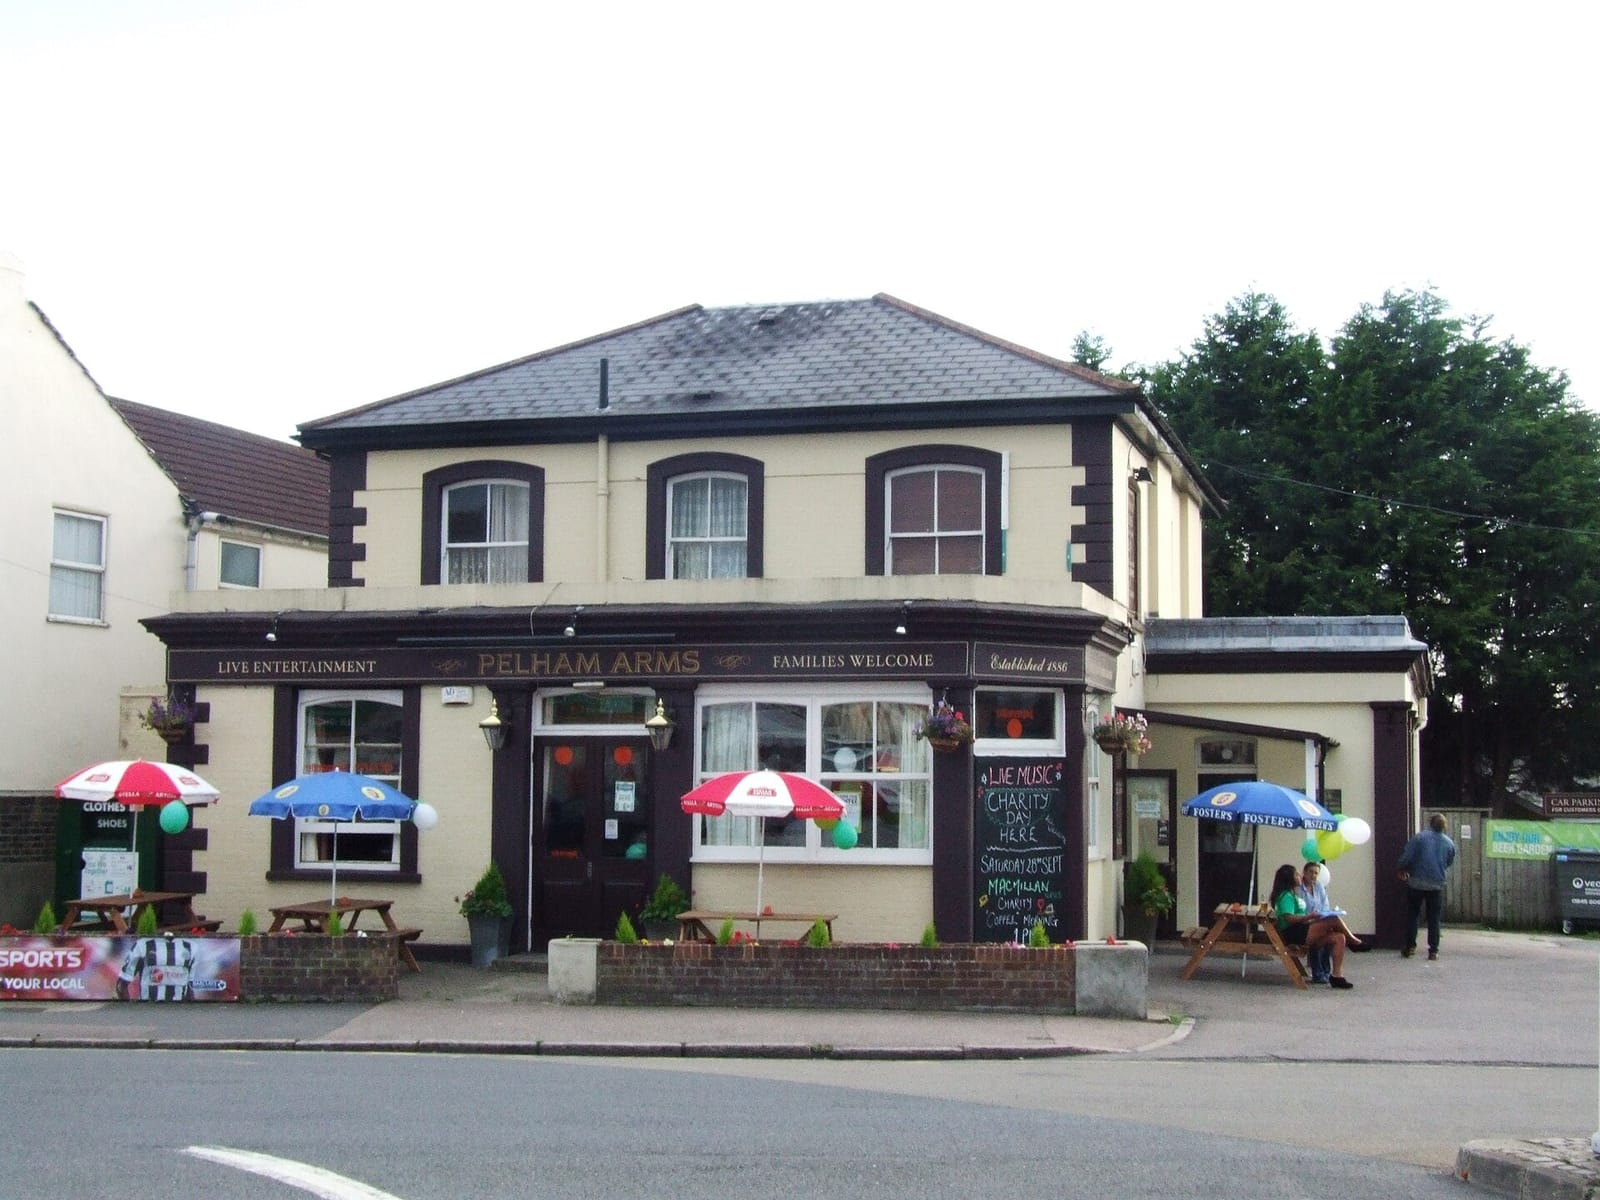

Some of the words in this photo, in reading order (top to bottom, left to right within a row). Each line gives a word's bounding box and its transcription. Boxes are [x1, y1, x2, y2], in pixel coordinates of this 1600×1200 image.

[218, 661, 249, 674] LIVE
[253, 660, 377, 674] ENTERTAINMENT
[477, 653, 601, 676] PELHAM
[610, 650, 701, 674] ARMS
[773, 655, 845, 669] FAMILIES
[850, 653, 934, 668] WELCOME
[990, 652, 1045, 672] Established
[1046, 661, 1068, 672] 1886
[989, 767, 1015, 786] LIVE
[1017, 764, 1054, 786] MUSIC
[83, 801, 125, 812] CLOTHES
[987, 791, 1049, 812] CHARITY
[1551, 798, 1569, 807] CAR
[1006, 810, 1031, 826] DAY
[1193, 807, 1233, 821] FOSTER'S
[1244, 813, 1294, 828] FOSTER'S
[98, 818, 127, 828] SHOES
[1000, 826, 1038, 843] HERE
[980, 855, 1025, 874] SATURDAY
[1041, 855, 1065, 875] SEPT
[988, 878, 1049, 897] MACMILLAN
[997, 896, 1032, 911] CHARITY
[0, 951, 81, 968] SPORTS
[5, 978, 40, 989] YOUR
[43, 979, 85, 989] LOCAL
